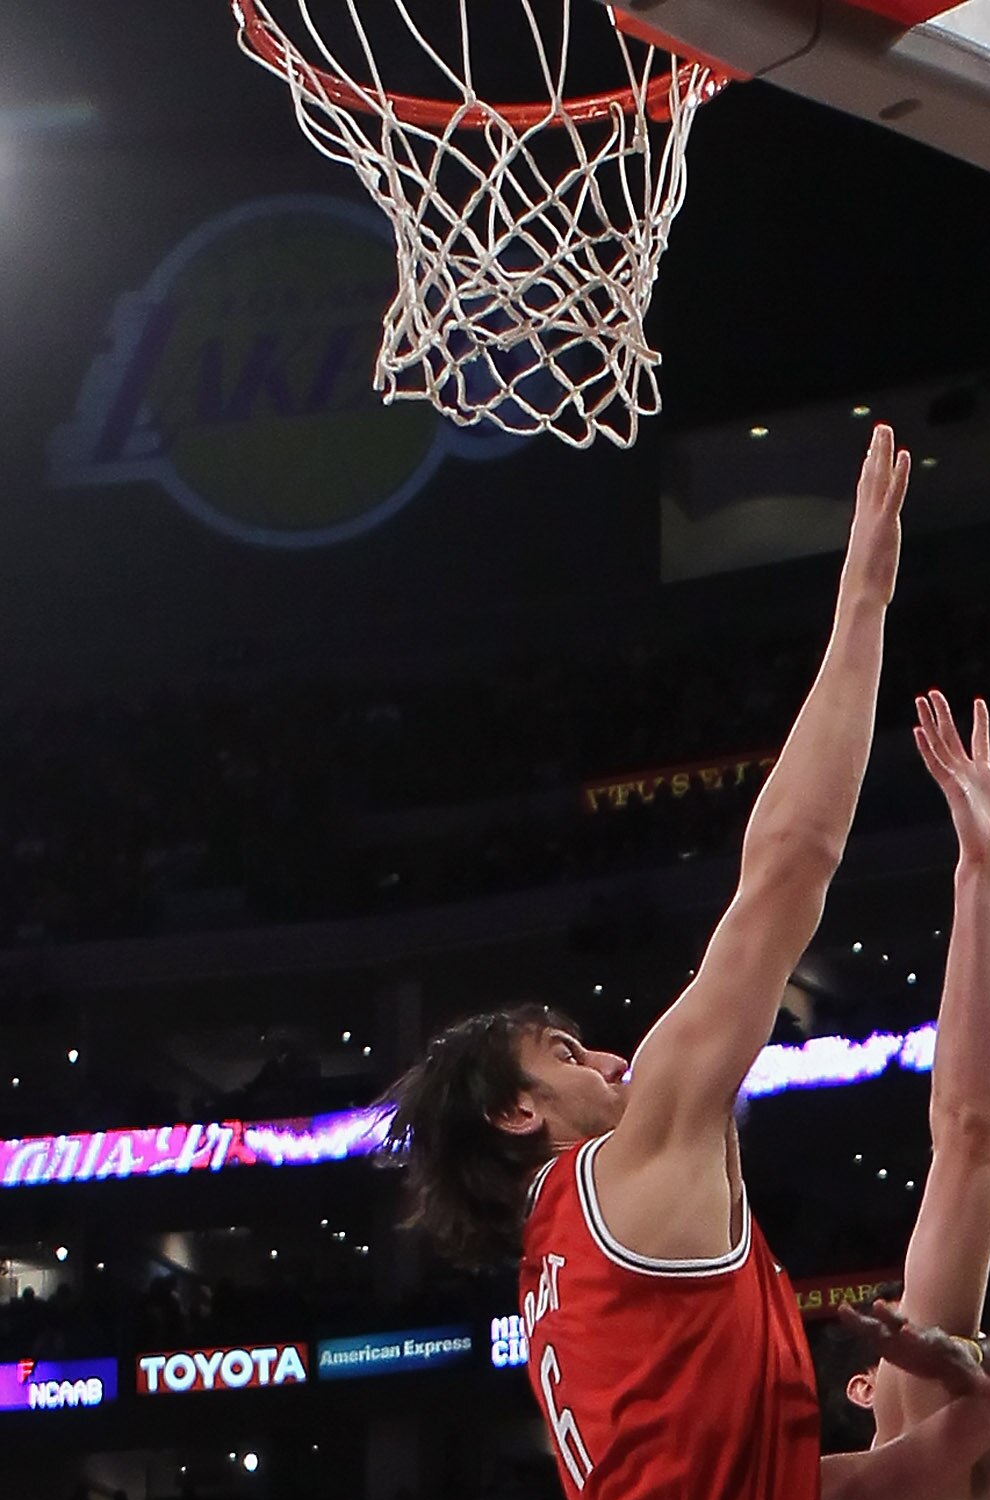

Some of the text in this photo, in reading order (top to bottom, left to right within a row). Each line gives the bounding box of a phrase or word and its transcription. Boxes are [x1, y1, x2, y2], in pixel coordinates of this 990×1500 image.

[319, 1336, 472, 1367] American Express
[139, 1346, 306, 1393] TOYOTA
[29, 1377, 103, 1410] NCAAB
